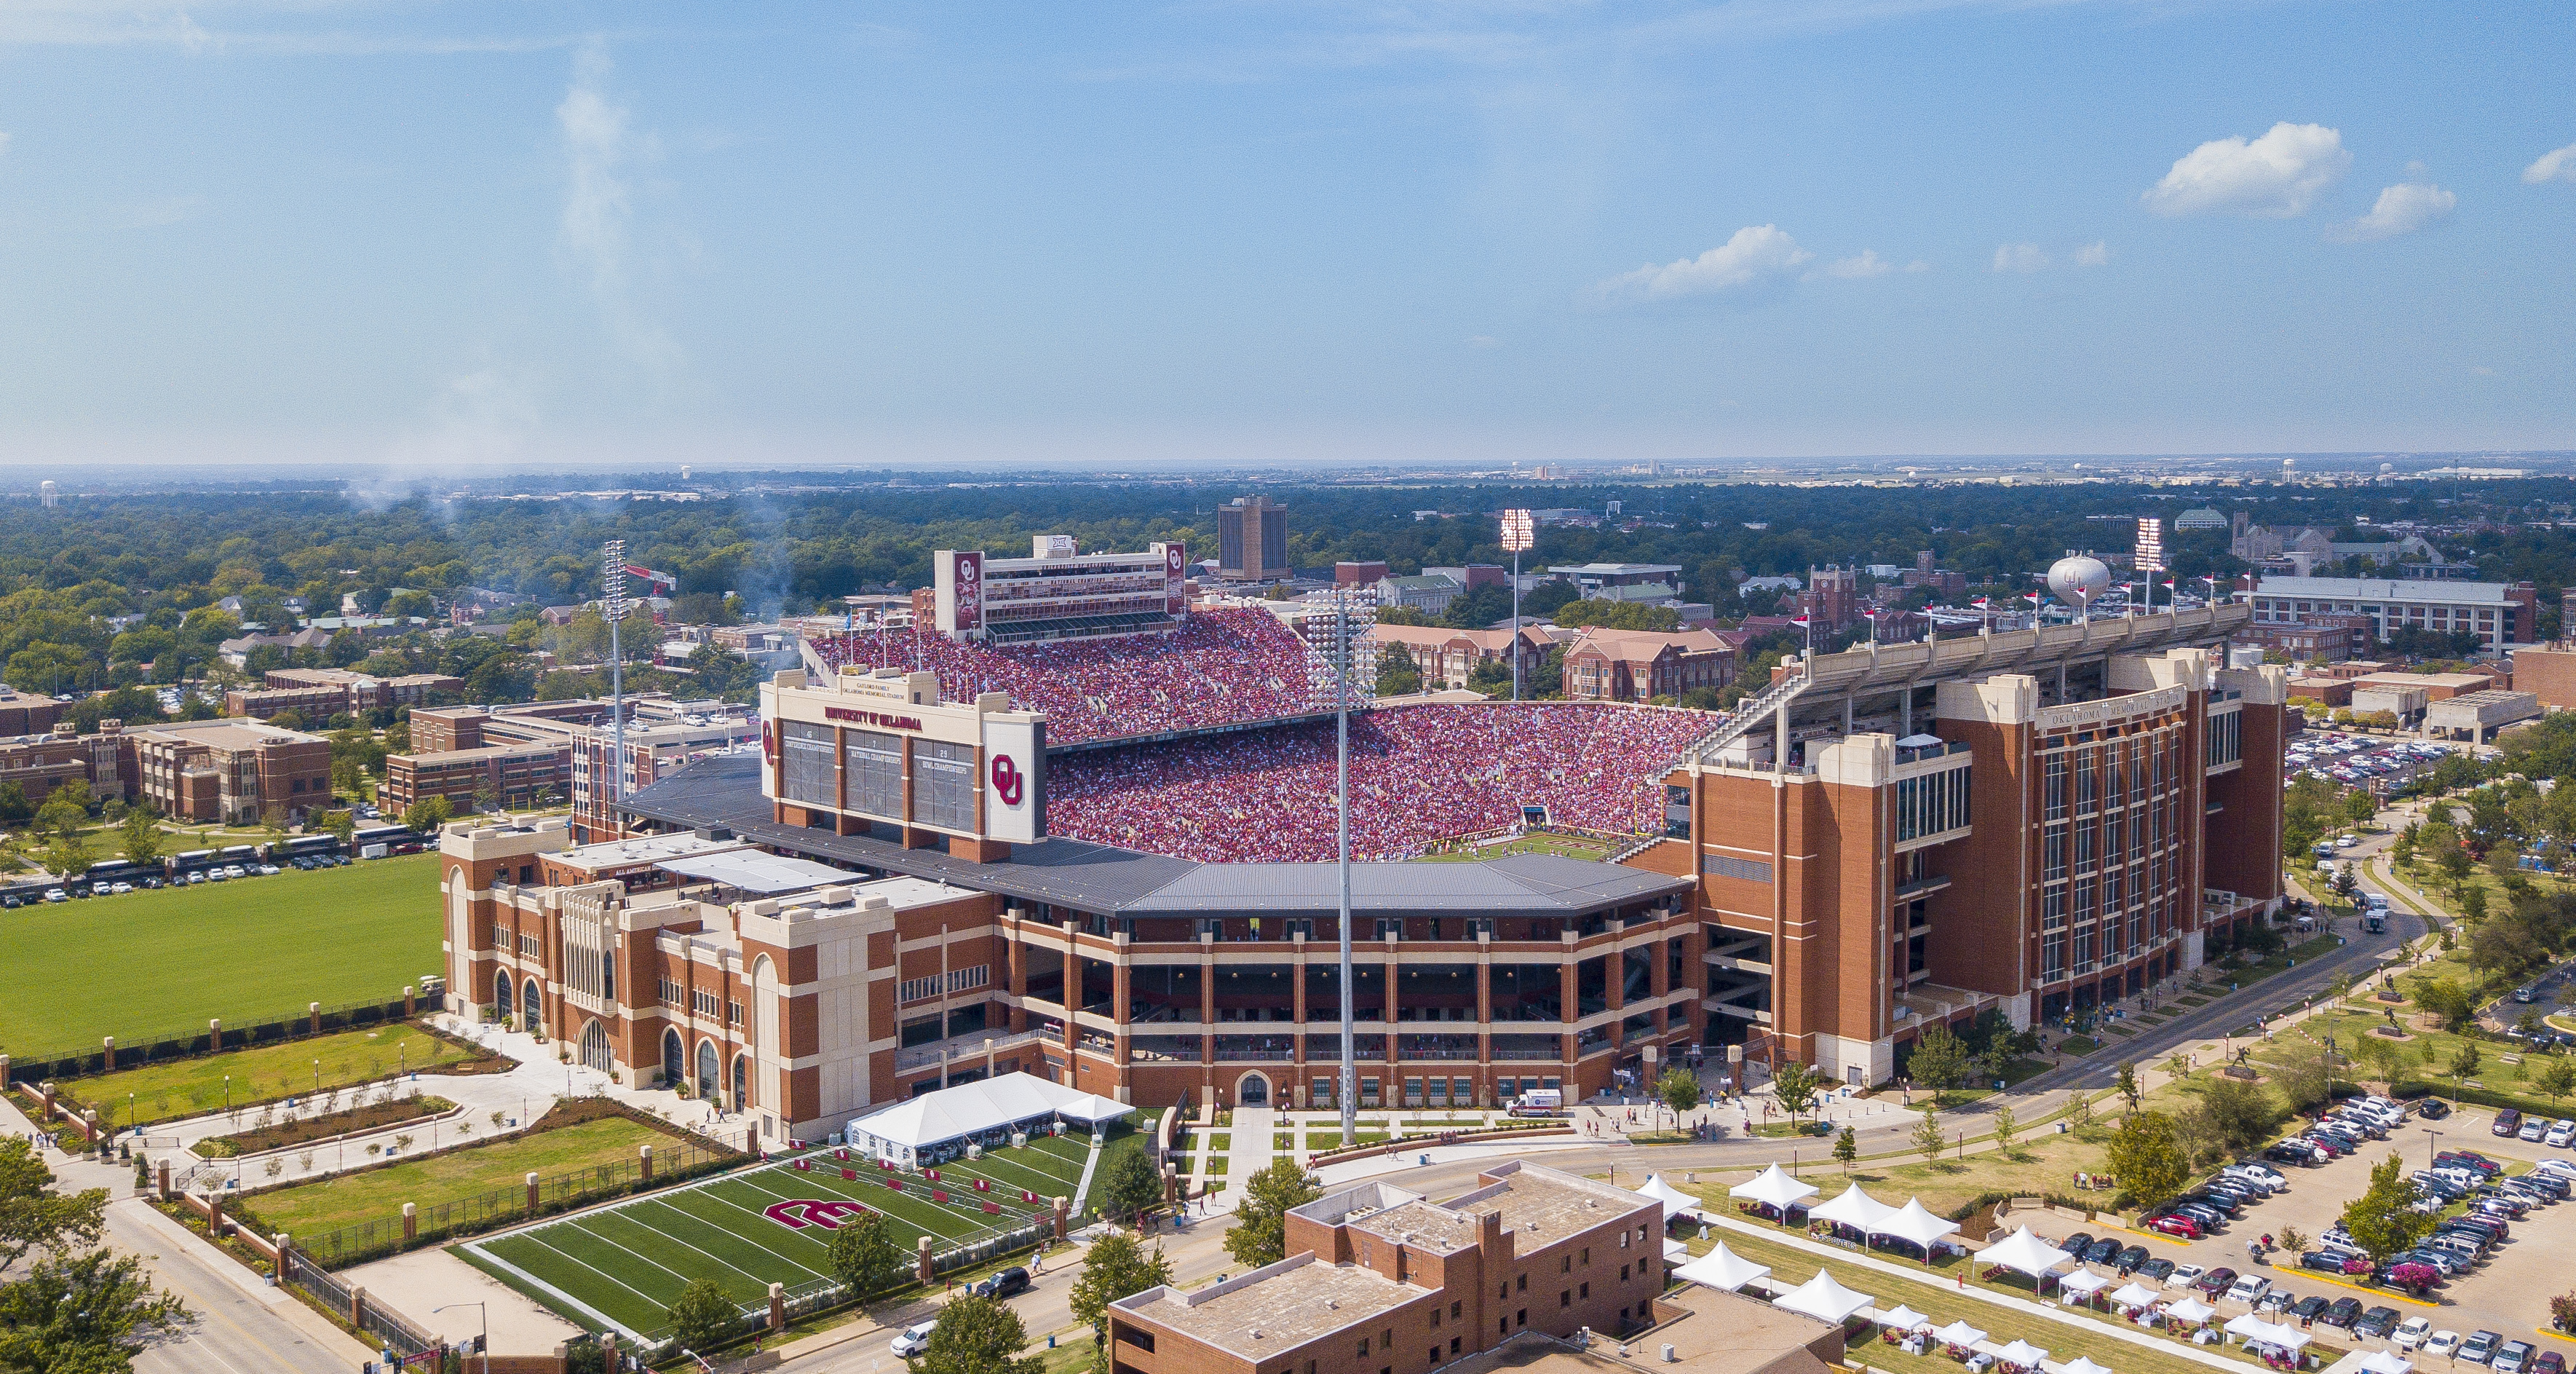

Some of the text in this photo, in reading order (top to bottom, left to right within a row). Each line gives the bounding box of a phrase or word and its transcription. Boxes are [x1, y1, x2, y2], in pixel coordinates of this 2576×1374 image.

[1170, 550, 1181, 569] OU
[962, 560, 974, 580] OU
[2053, 693, 2180, 724] OKLAHOMA MEMORIAL STADIUM
[825, 706, 922, 731] UNIVERSITY OF OKLAHOMA
[940, 749, 948, 758] 29
[922, 760, 934, 769] BOWL
[991, 754, 1023, 805] OU
[627, 865, 651, 874] AMERICAN
[1818, 1234, 1857, 1250] #SOONERS
